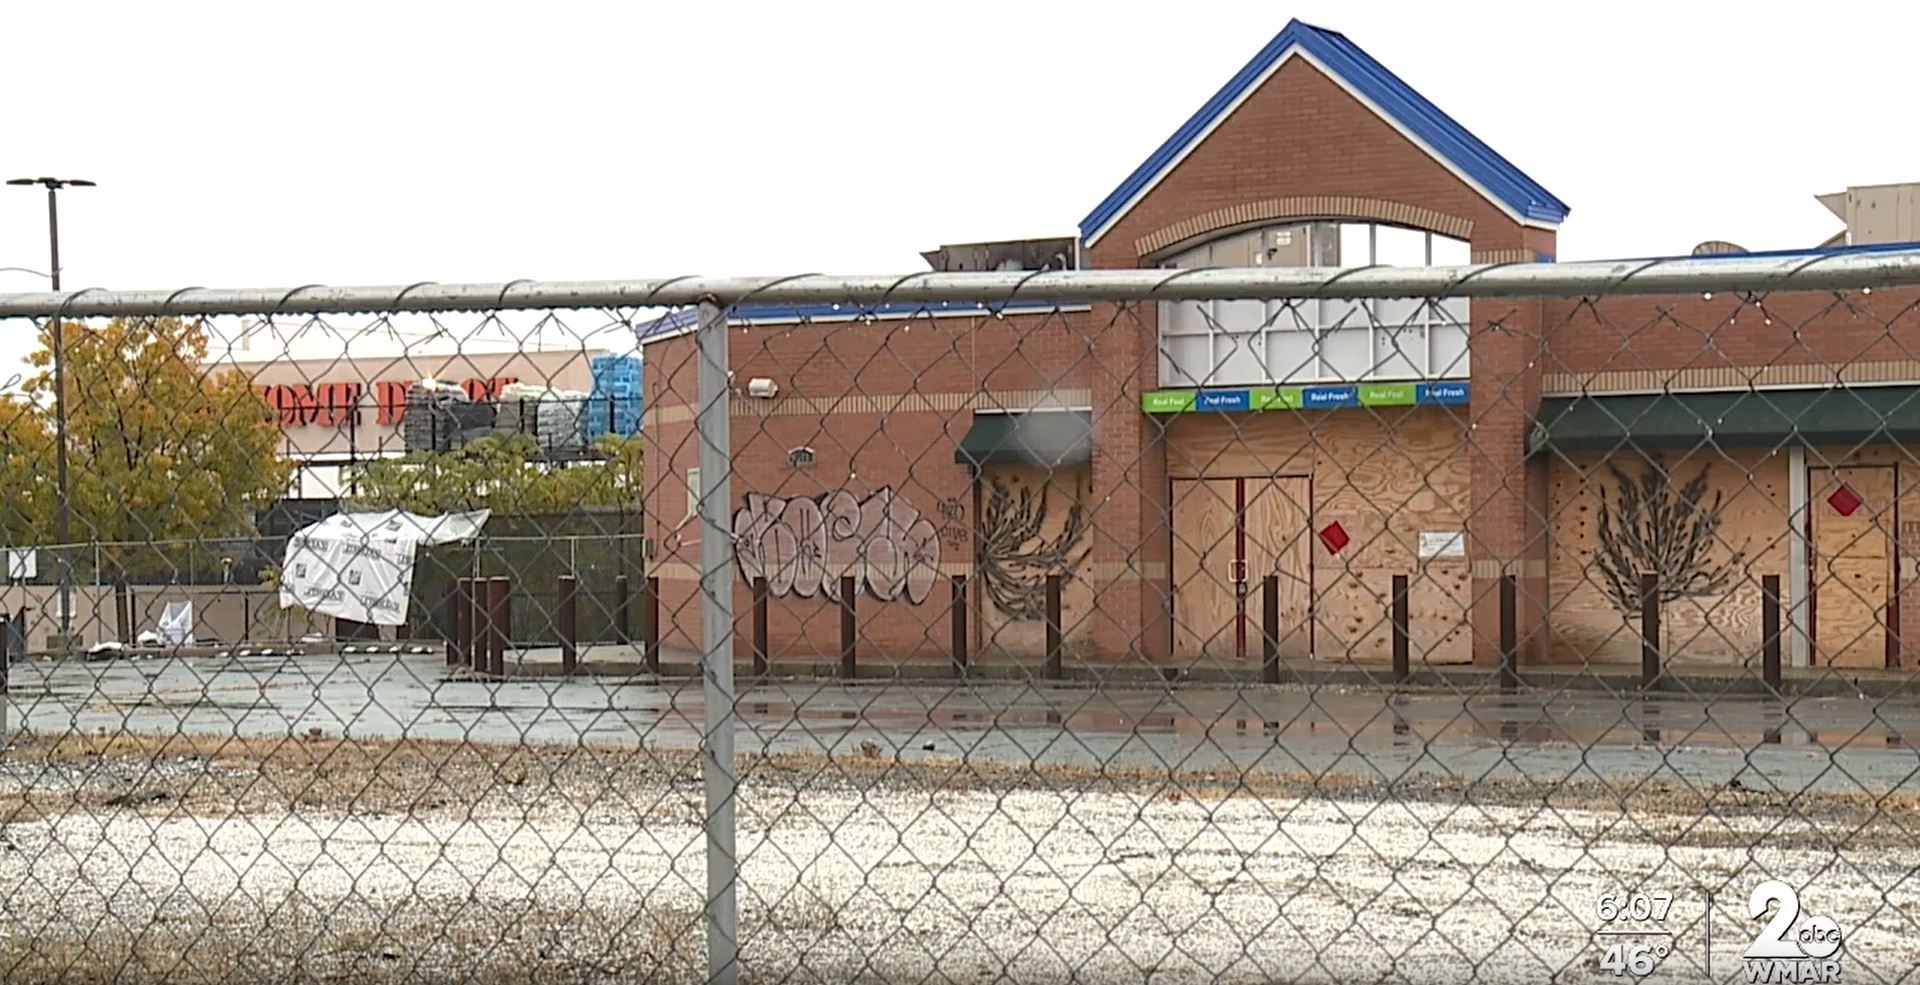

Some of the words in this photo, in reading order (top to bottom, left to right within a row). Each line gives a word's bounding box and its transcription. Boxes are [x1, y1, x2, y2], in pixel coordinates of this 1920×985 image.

[260, 384, 361, 427] OME
[1221, 394, 1241, 405] Fresh
[1311, 391, 1328, 401] Real
[1328, 390, 1349, 401] Fresh
[1441, 387, 1465, 397] Fresh
